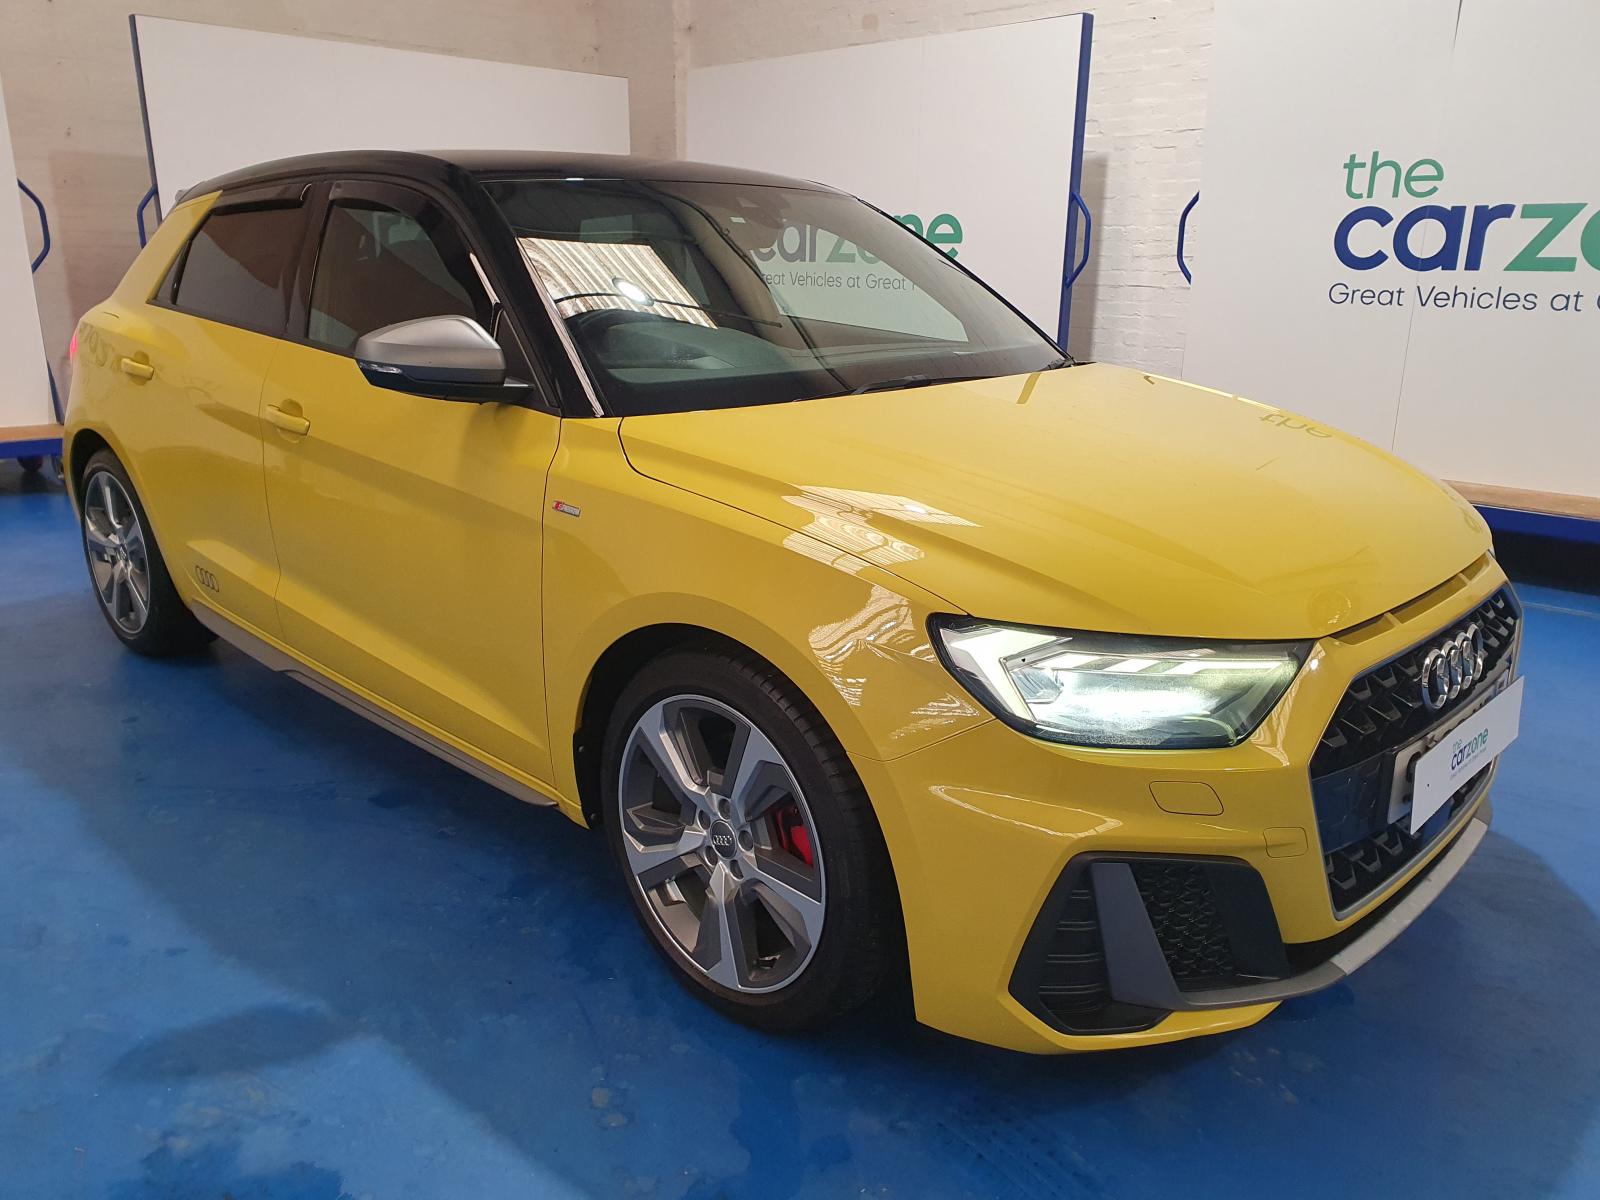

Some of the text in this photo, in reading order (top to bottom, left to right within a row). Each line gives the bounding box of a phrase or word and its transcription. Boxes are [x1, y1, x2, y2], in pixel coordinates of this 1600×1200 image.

[1343, 150, 1445, 200] the
[1333, 202, 1600, 272] carz
[789, 271, 842, 289] Vehicles
[846, 274, 861, 289] at
[865, 273, 907, 291] Great
[1328, 282, 1405, 307] Great
[1416, 284, 1539, 311] Vehicles
[1550, 290, 1584, 312] at
[1451, 728, 1488, 770] carzone
